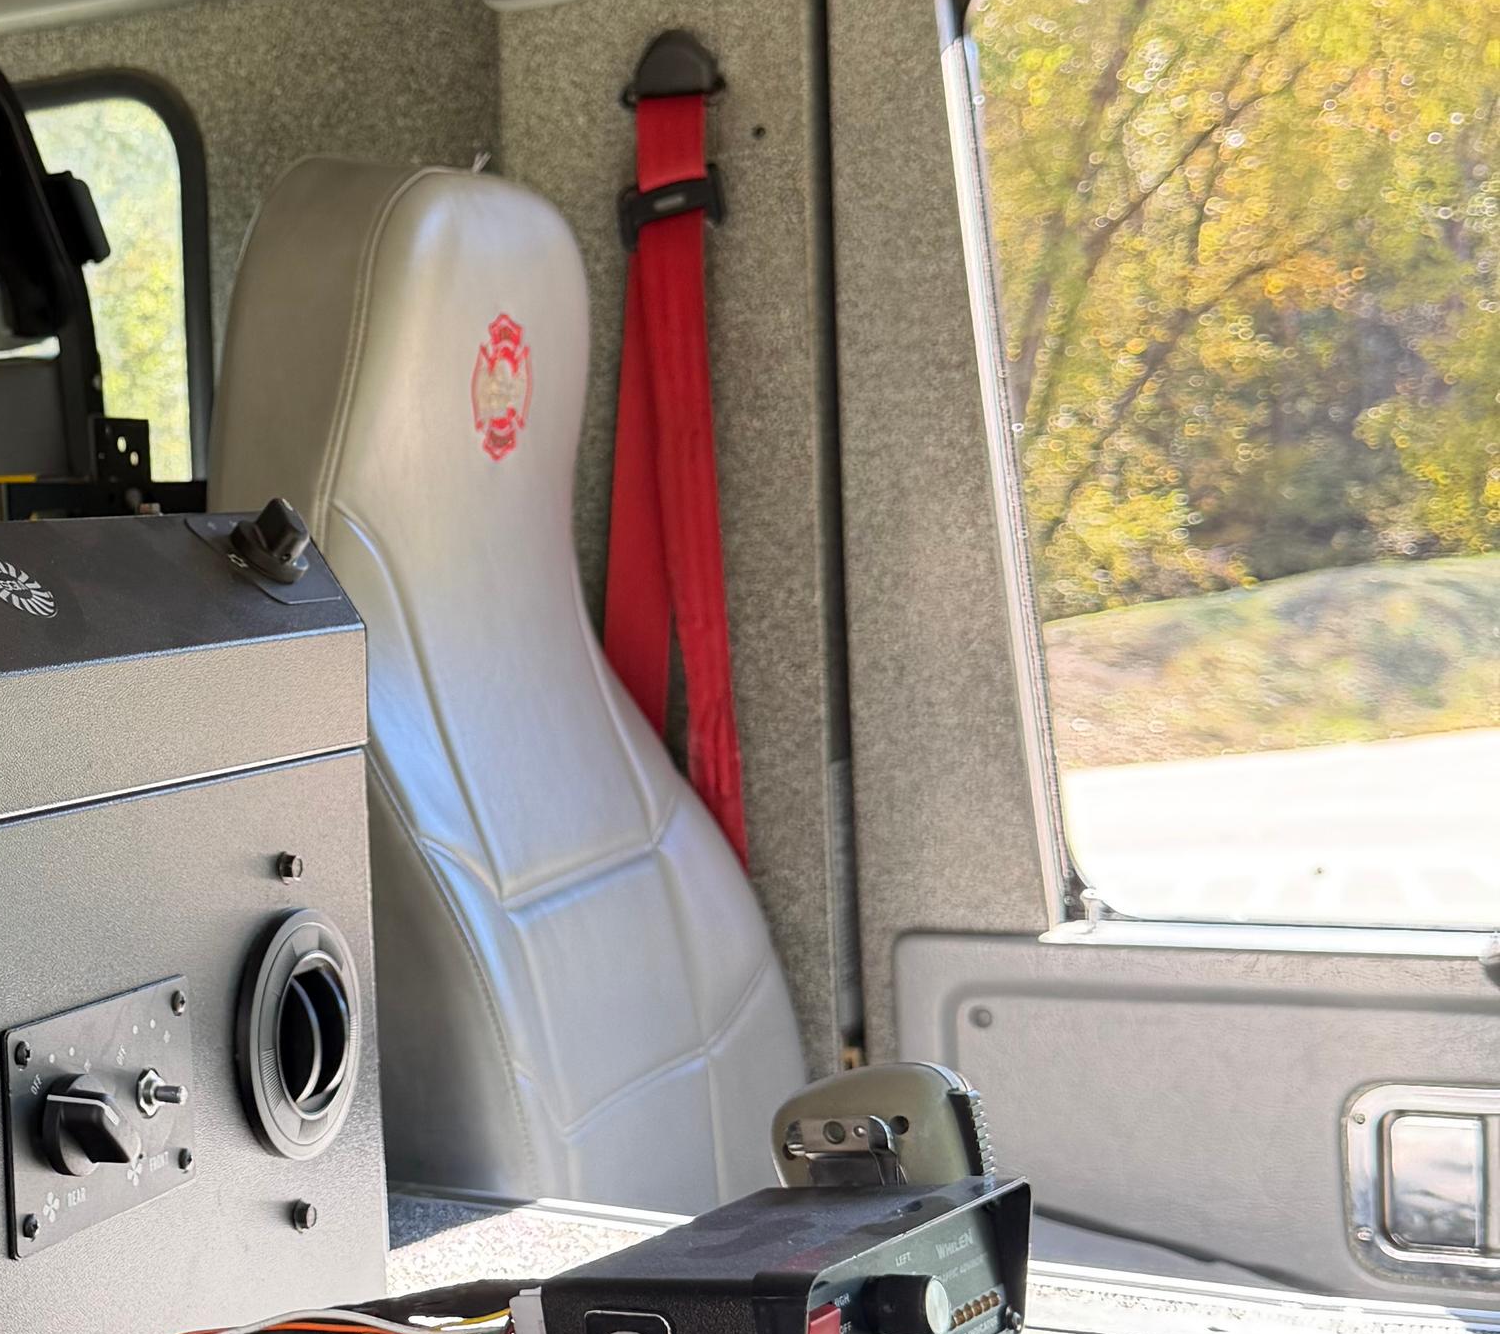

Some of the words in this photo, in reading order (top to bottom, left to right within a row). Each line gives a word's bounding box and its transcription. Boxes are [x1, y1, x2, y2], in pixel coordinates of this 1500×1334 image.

[116, 1043, 127, 1066] OFF
[31, 1074, 43, 1095] OFF
[150, 1151, 169, 1171] FRONT
[67, 1187, 86, 1207] REAR
[895, 1252, 912, 1267] LEFT
